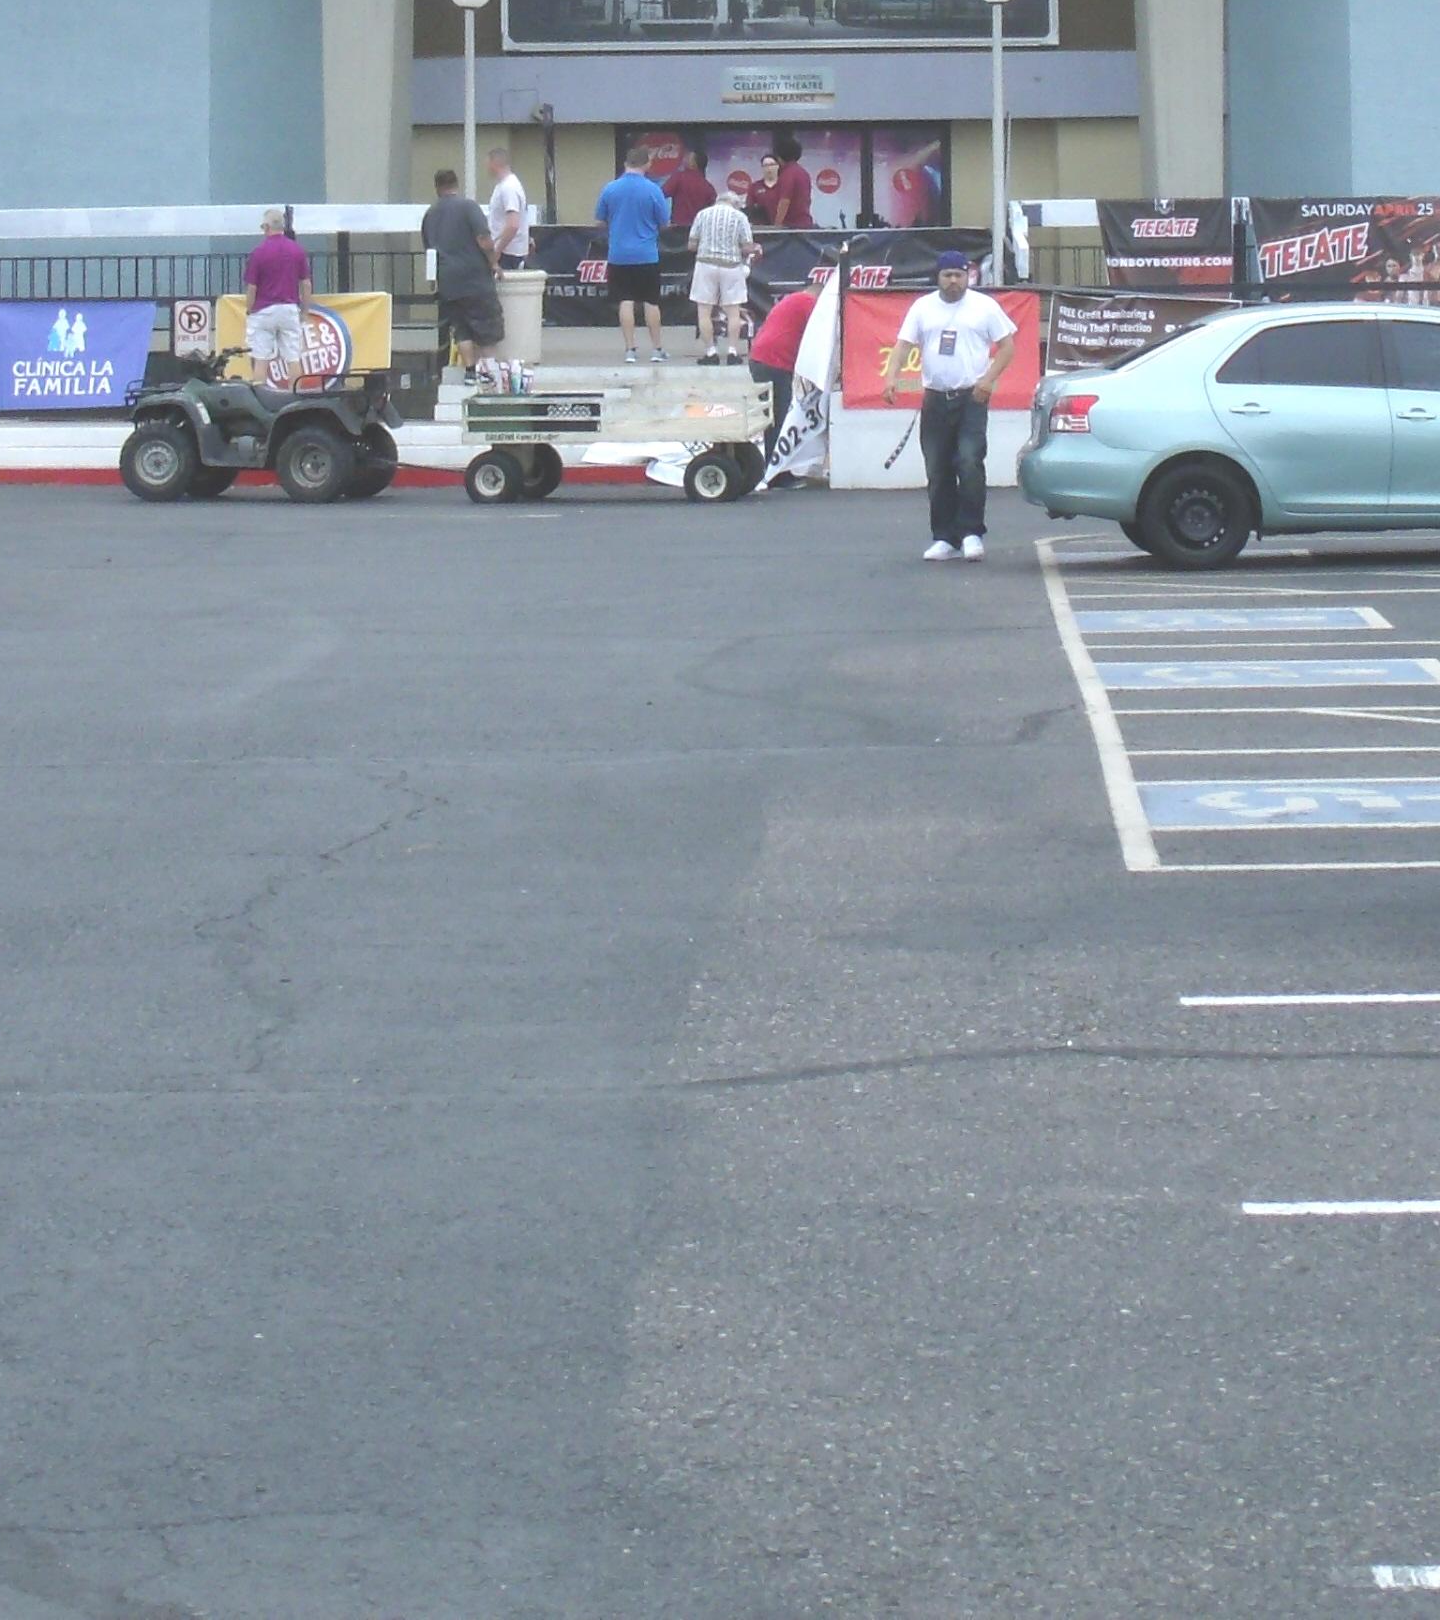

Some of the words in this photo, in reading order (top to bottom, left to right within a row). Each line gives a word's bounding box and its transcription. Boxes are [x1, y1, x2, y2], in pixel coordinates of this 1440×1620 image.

[1301, 204, 1374, 217] SATURDAY
[1417, 203, 1434, 216] 25
[1131, 217, 1199, 238] TECATE
[1260, 222, 1369, 278] TECATE
[1060, 306, 1076, 319] FREE
[1077, 309, 1101, 320] Credit
[1103, 310, 1147, 321] Monitoring
[1089, 322, 1110, 333] Theft
[1111, 322, 1152, 333] Protection
[12, 357, 86, 377] CLÍNICA
[90, 360, 114, 376] LA
[13, 376, 112, 396] FAMILIA
